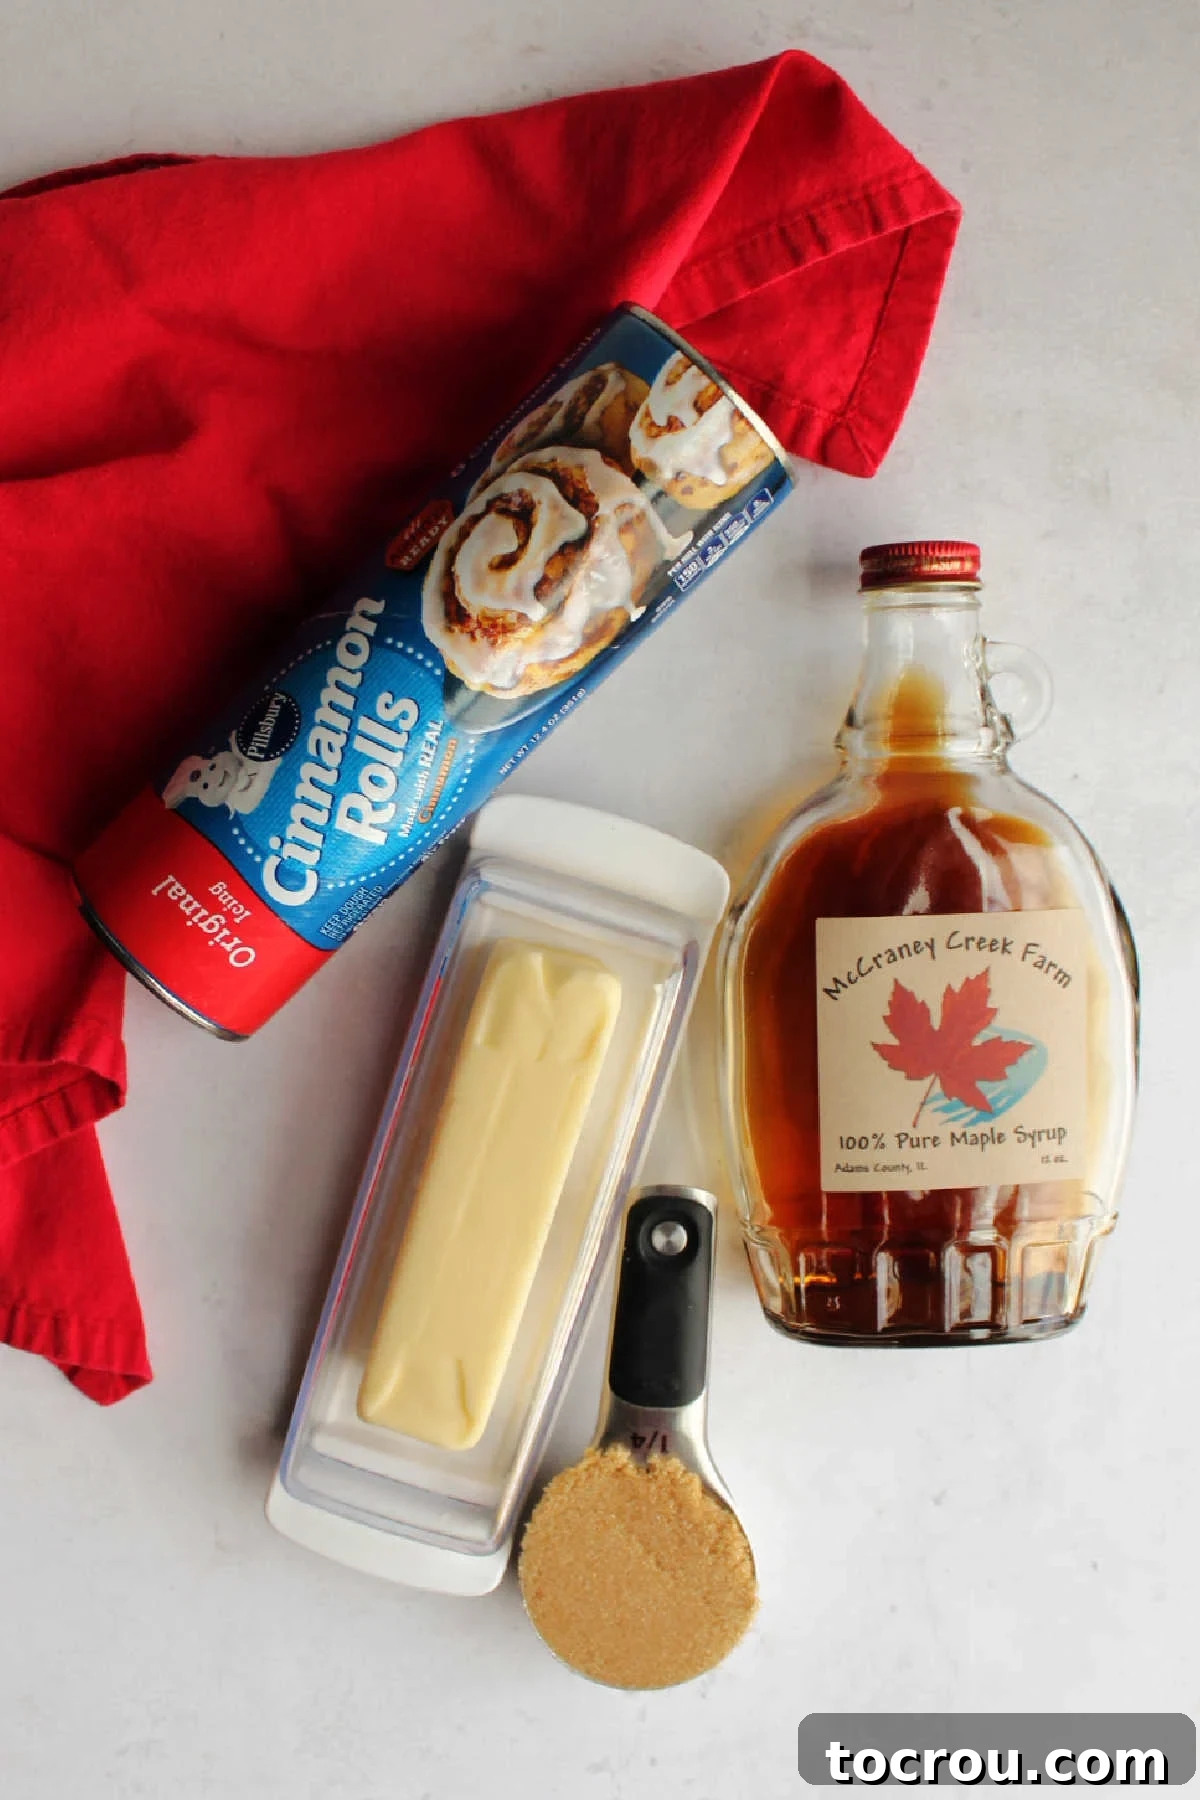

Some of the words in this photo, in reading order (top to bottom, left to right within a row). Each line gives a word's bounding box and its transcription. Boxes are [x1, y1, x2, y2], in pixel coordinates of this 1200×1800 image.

[246, 692, 287, 758] Pillsbury
[418, 719, 445, 768] REAL
[263, 597, 386, 905] Cinnamon
[334, 691, 420, 845] Rolls
[499, 758, 516, 775] NET
[514, 744, 529, 758] WT
[414, 769, 431, 803] with
[418, 737, 458, 824] Cinnamon
[398, 802, 420, 837] Made
[151, 873, 257, 968] Original
[208, 881, 252, 923] Icing
[320, 913, 341, 936] KEEP
[339, 886, 369, 916] DOUGH
[327, 884, 383, 939] REFRIGERATED
[822, 937, 936, 1001] McCraney
[945, 930, 1014, 955] Creek
[1021, 942, 1073, 989] Farm
[839, 1132, 887, 1150] 100%
[895, 1132, 941, 1150] Pure
[950, 1127, 1006, 1152] Maple
[1013, 1125, 1068, 1149] Syrup
[834, 1162, 870, 1174] Adams
[873, 1162, 913, 1176] County,
[630, 1431, 668, 1453] 1/4
